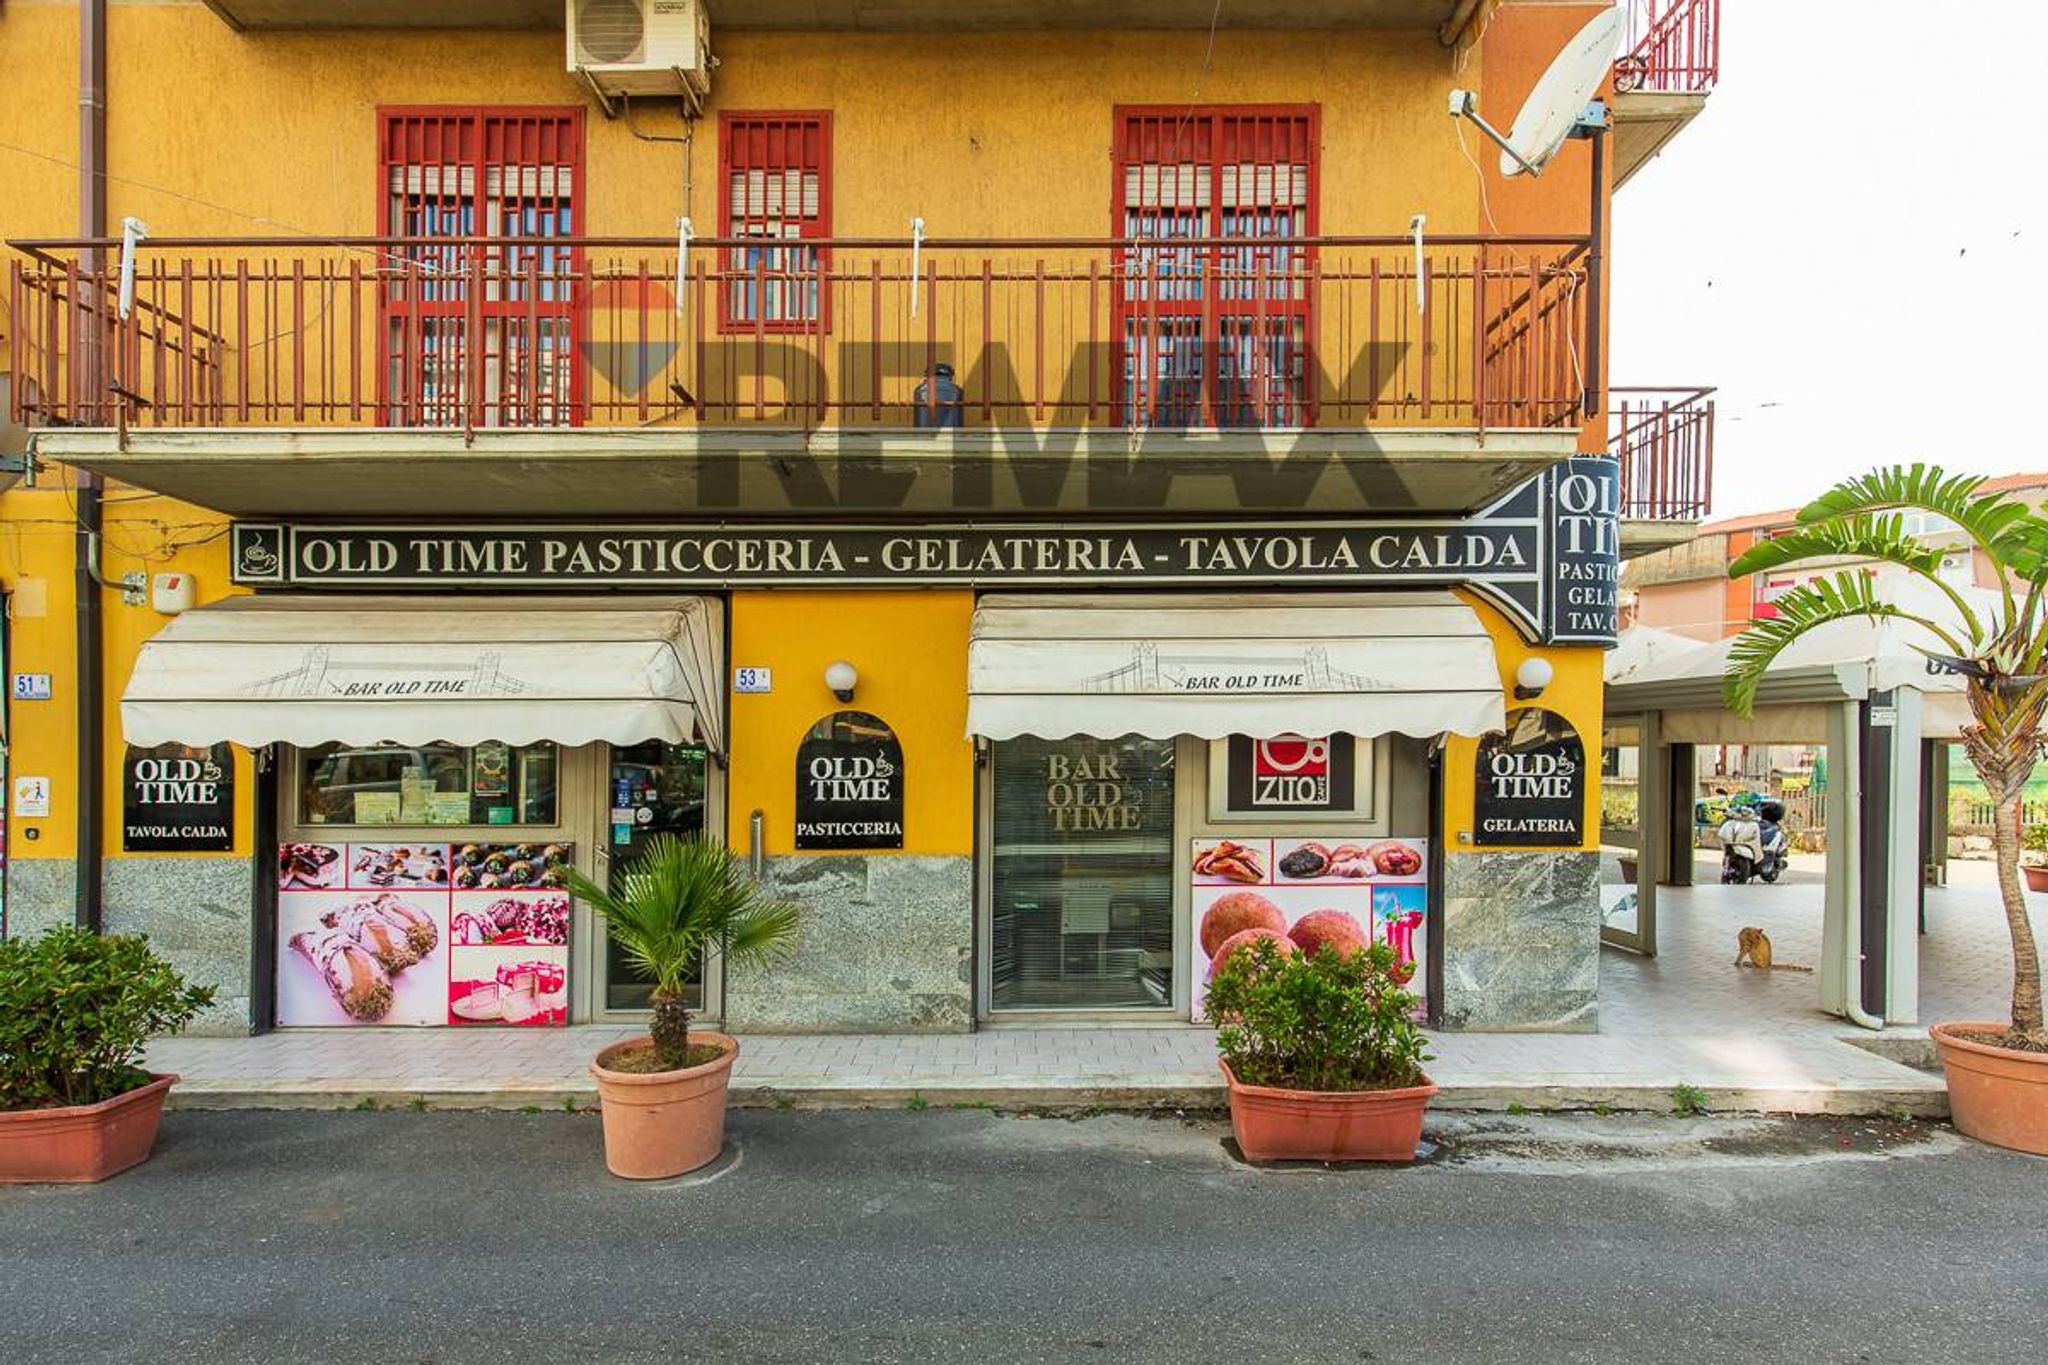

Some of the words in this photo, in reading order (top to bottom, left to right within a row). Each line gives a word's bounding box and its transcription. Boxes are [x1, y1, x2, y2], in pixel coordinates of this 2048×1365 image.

[302, 539, 398, 573] OLD
[409, 540, 529, 573] TIME
[541, 539, 846, 573] PASTICCERIA
[882, 538, 1145, 571] GELATERIA
[1180, 536, 1359, 570] TAVOLA
[1370, 534, 1526, 568] CALDA
[18, 676, 33, 692] 51
[343, 682, 382, 696] BAR
[384, 681, 421, 695] OLD
[423, 680, 466, 693] TIME
[740, 669, 756, 686] 53
[1186, 677, 1220, 689] BAR
[1225, 676, 1258, 688] OLD
[1263, 674, 1304, 687] TIME
[135, 759, 200, 781] OLD
[810, 757, 875, 780] OLD
[1048, 753, 1121, 780] BAR
[1491, 754, 1556, 776] OLD
[135, 783, 218, 804] TIME
[810, 779, 891, 801] TIME
[1047, 783, 1121, 807] OLD
[1258, 776, 1316, 802] ZITO
[1491, 776, 1572, 798] TIME
[797, 822, 902, 836] PASTICCERIA
[1047, 806, 1141, 831] TIME
[1483, 819, 1576, 832] GELATERIA
[127, 826, 179, 838] TAVOLA
[181, 826, 228, 838] CALDA
